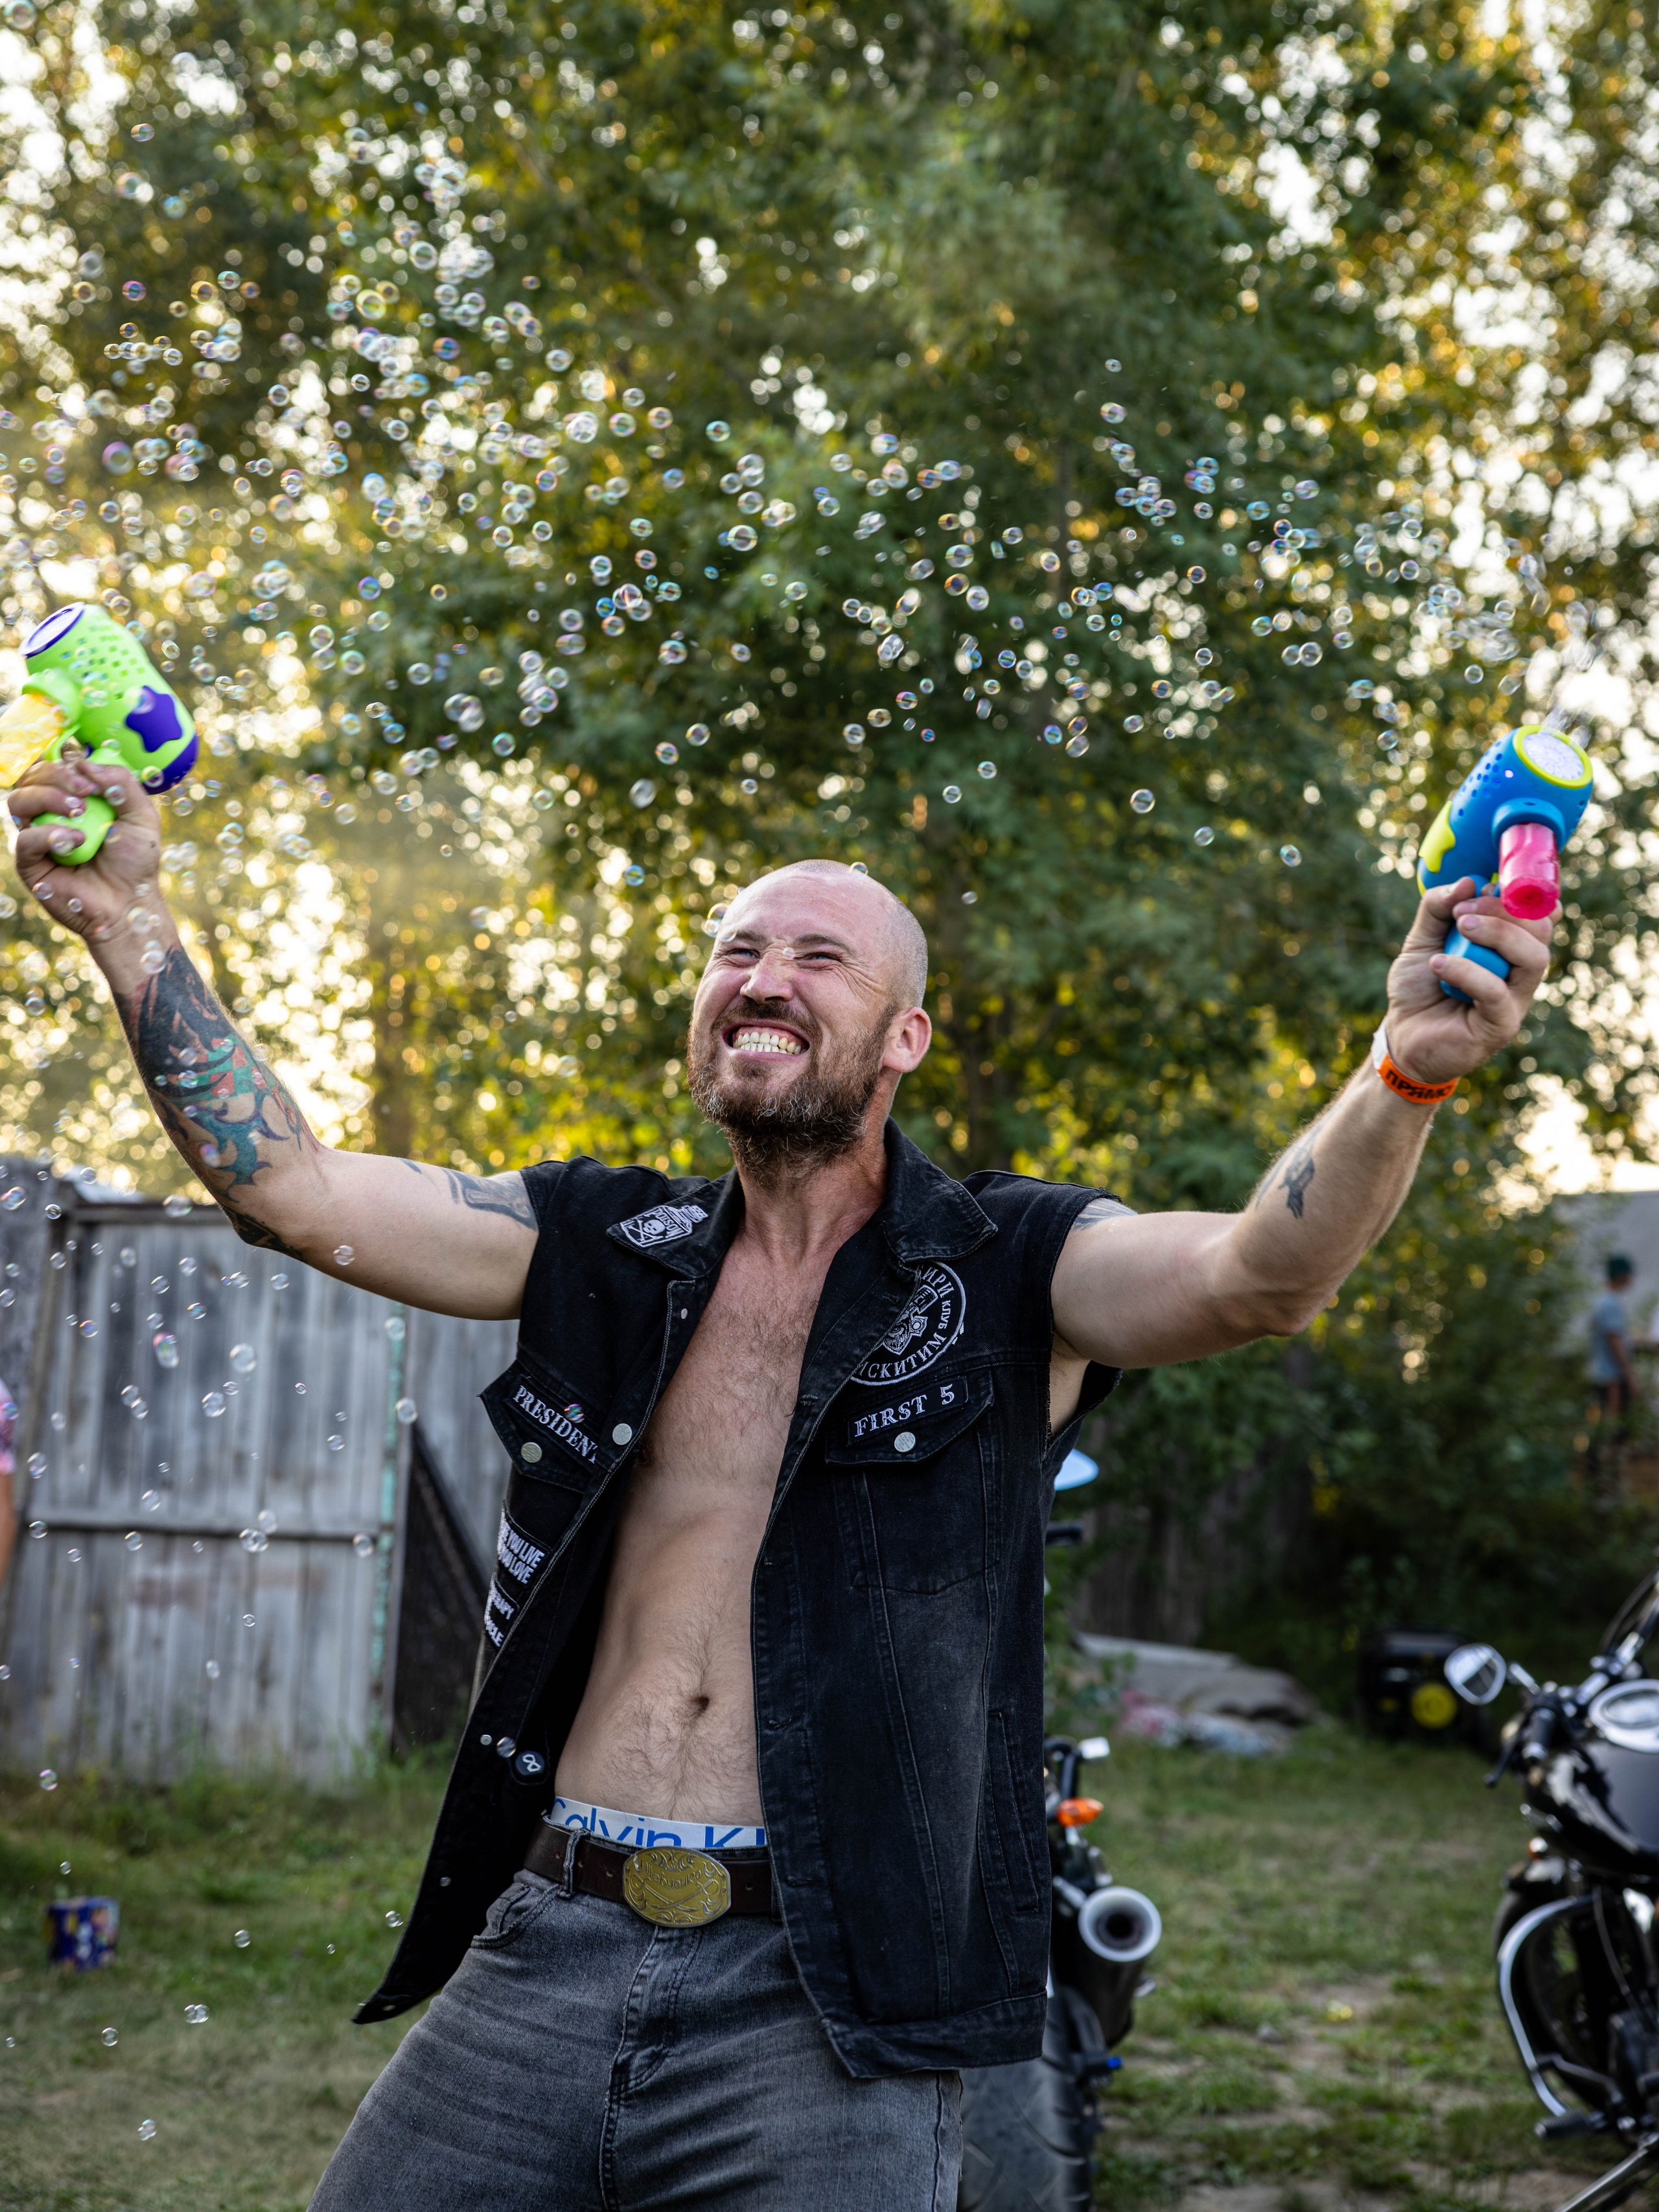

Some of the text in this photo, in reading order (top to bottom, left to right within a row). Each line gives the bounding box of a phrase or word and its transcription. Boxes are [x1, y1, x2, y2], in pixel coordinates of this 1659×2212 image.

[653, 1207, 685, 1239] POISON
[938, 1300, 951, 1330] КЛУБ
[854, 1384, 955, 1438] FIRST 5
[508, 1556, 535, 1585] LOVE
[518, 1542, 545, 1569] LIVE
